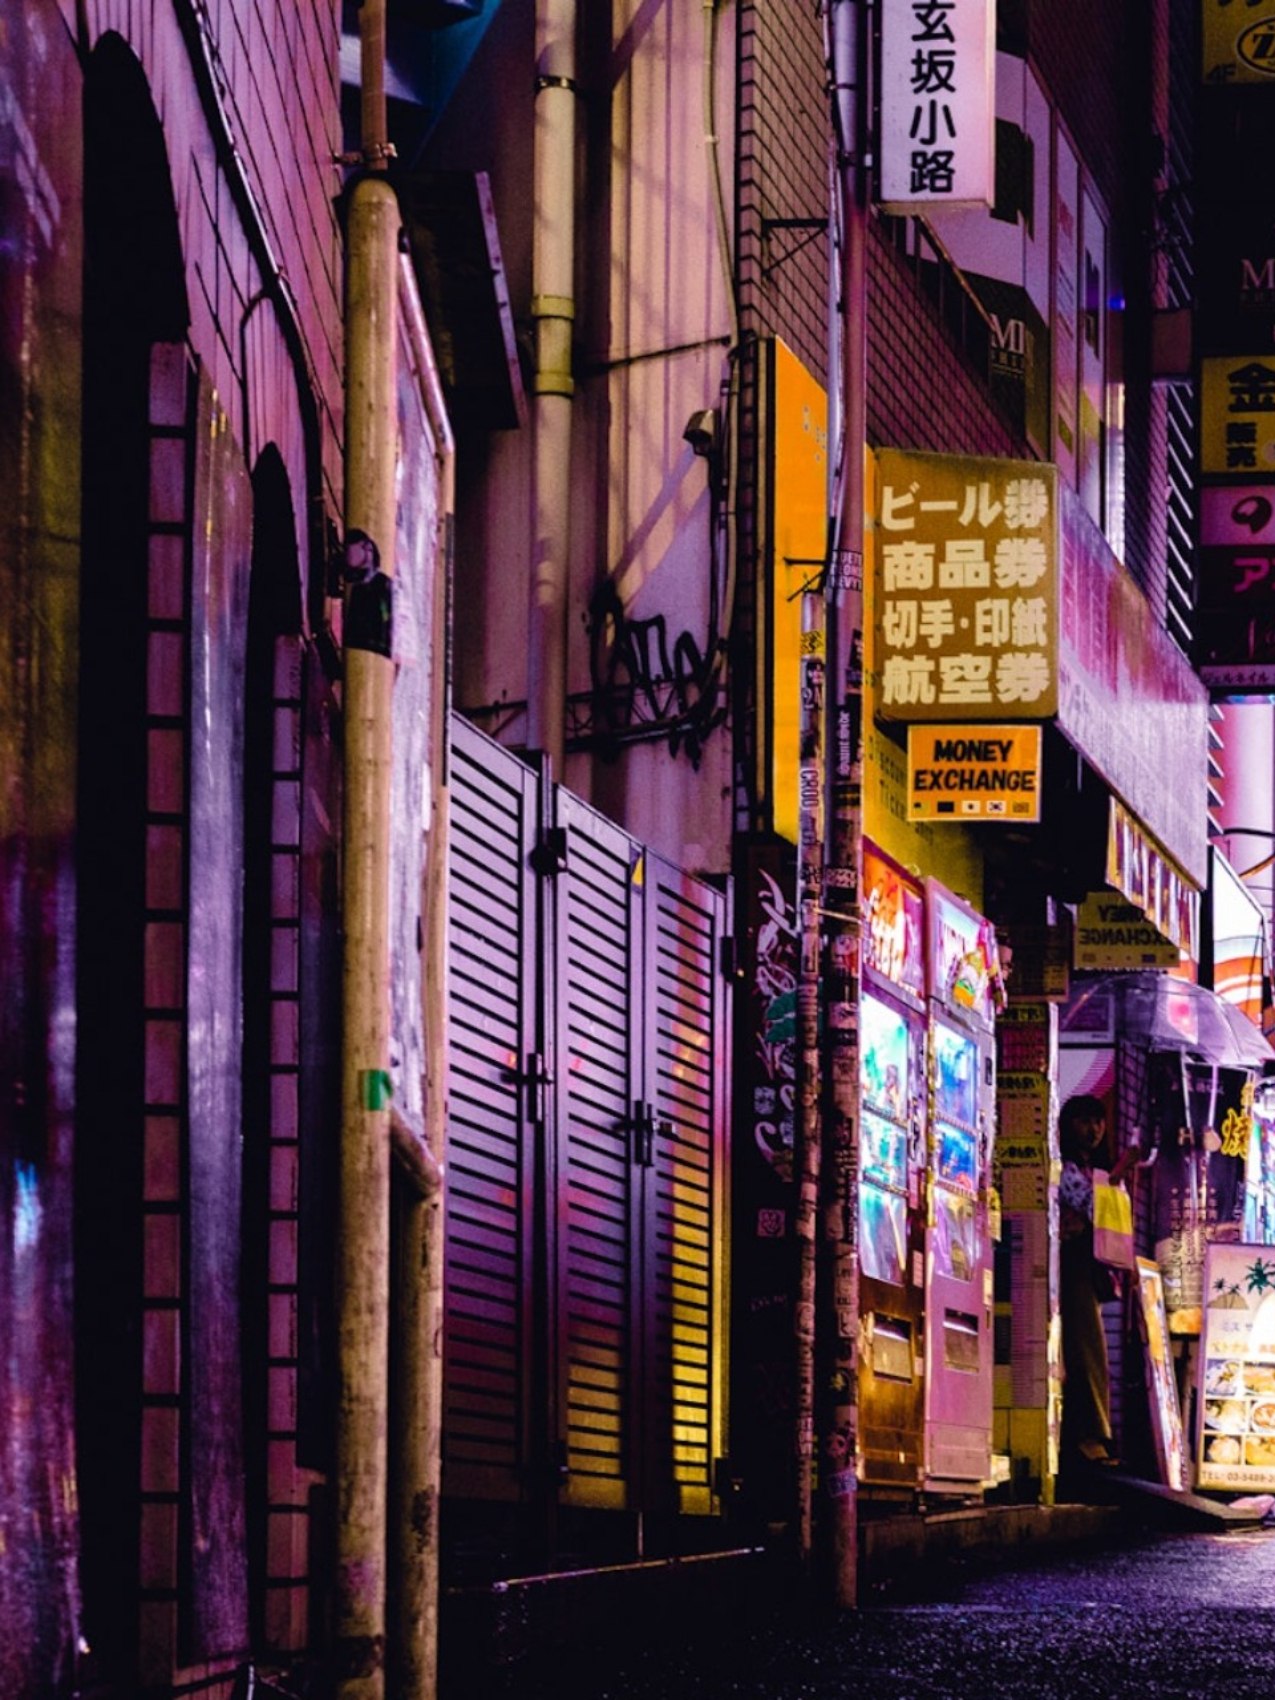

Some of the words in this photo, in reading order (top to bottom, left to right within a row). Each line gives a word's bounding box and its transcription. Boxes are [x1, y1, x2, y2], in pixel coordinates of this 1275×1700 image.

[881, 479, 1049, 532] ビール券
[882, 537, 1048, 591] 商品券
[882, 652, 1050, 705] 航空券
[933, 739, 1014, 763] MONEY
[914, 768, 1036, 792] EXCHANGE
